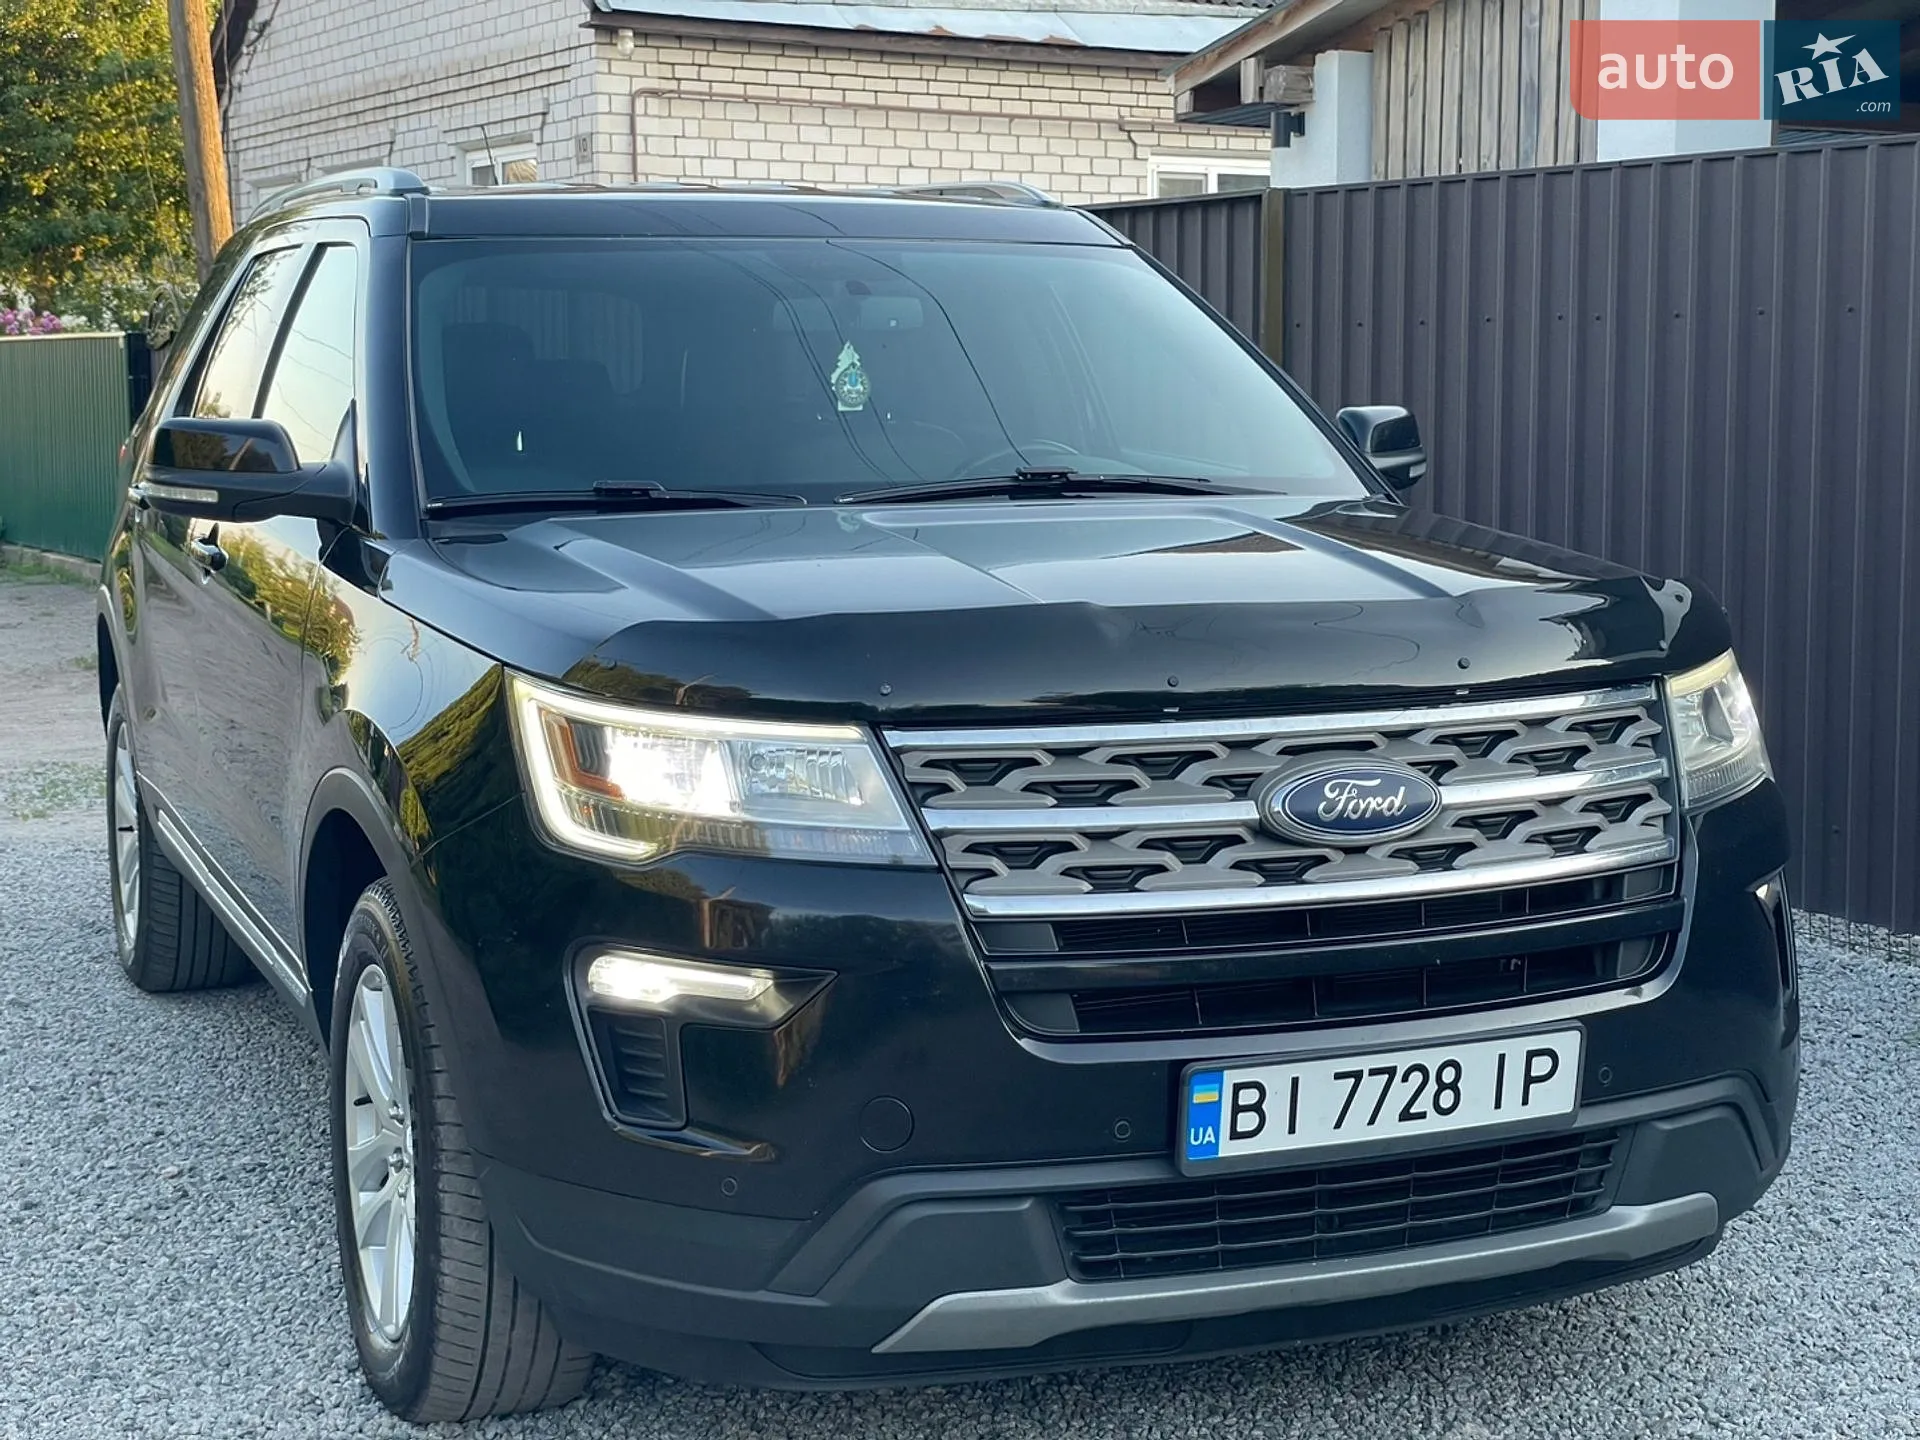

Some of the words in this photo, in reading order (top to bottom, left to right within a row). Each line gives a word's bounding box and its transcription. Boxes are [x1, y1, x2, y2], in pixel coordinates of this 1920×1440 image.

[1317, 778, 1407, 822] Ford
[1228, 1075, 1300, 1142] BI
[1332, 1058, 1463, 1131] 7728
[1493, 1047, 1560, 1111] IP
[1189, 1126, 1217, 1147] UA
